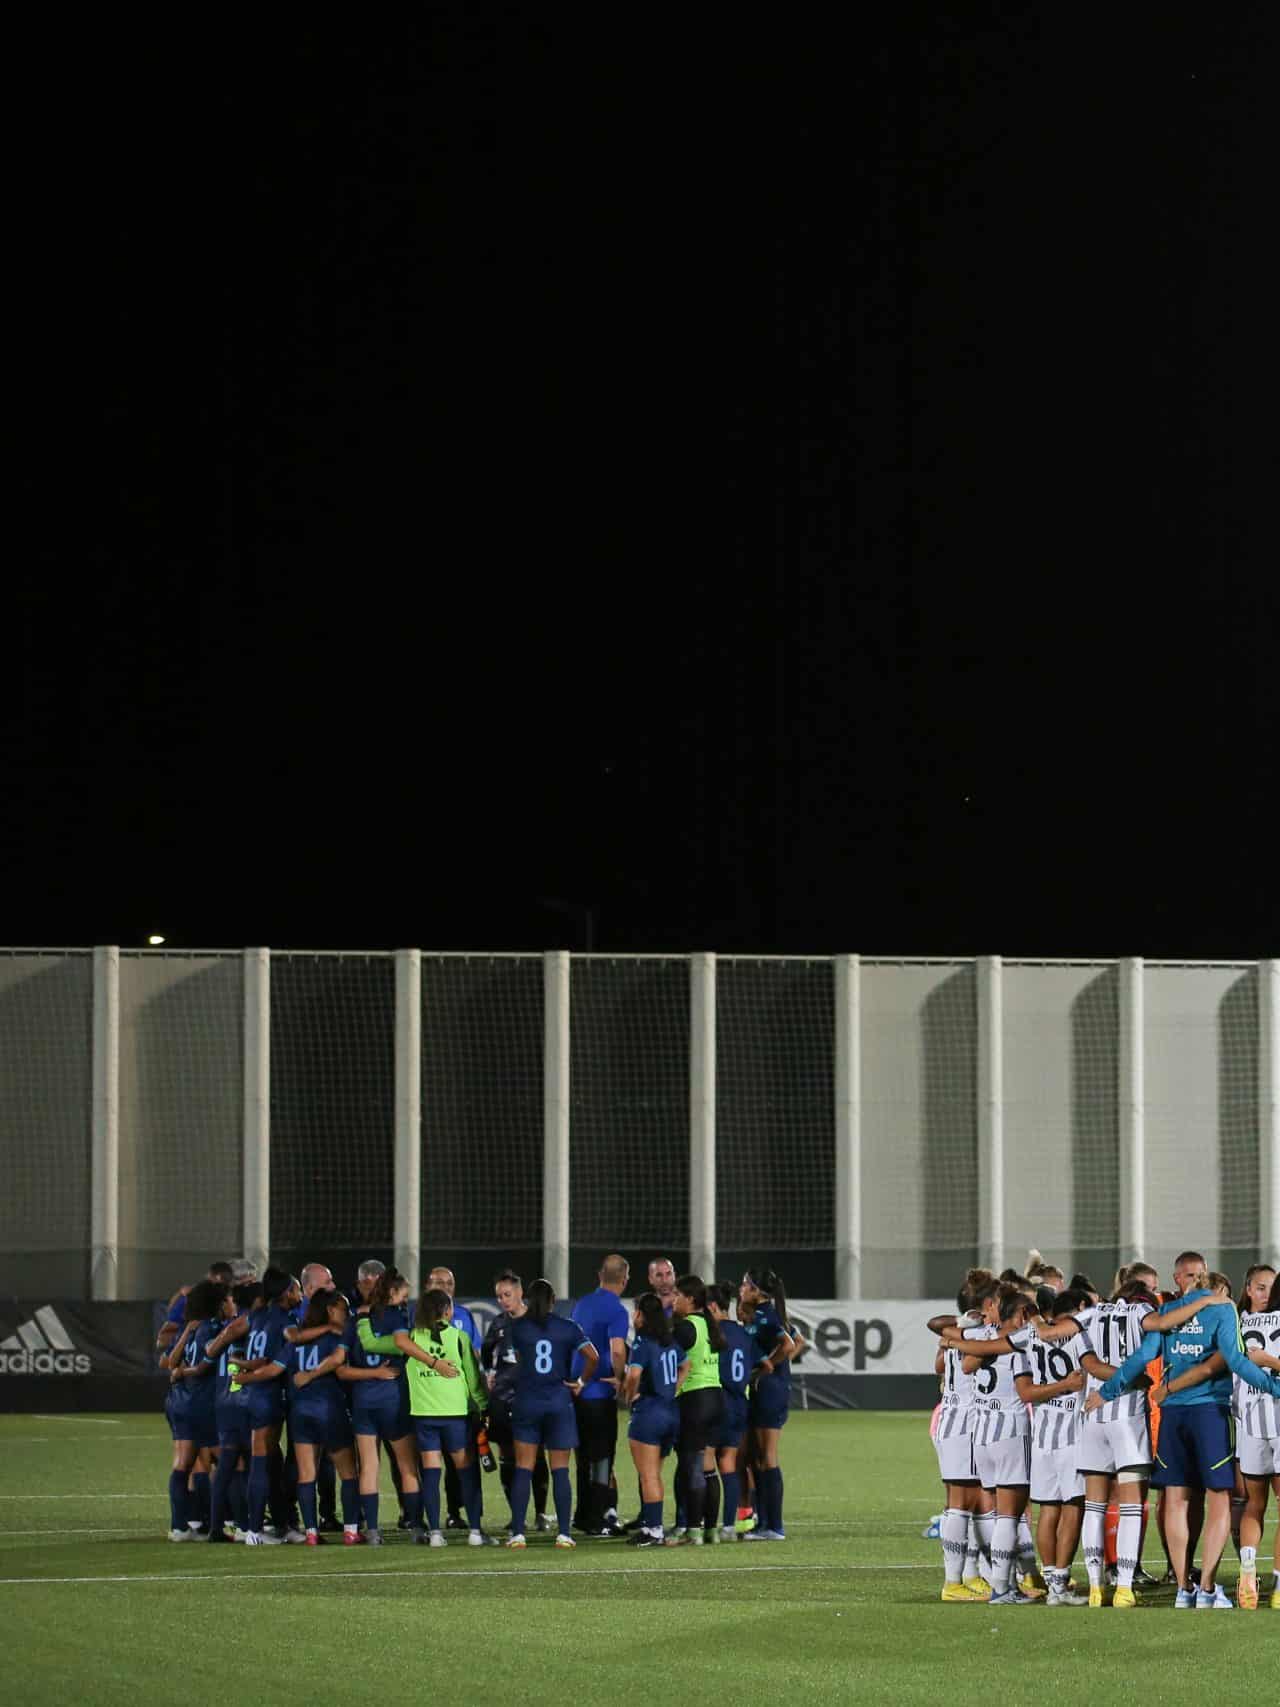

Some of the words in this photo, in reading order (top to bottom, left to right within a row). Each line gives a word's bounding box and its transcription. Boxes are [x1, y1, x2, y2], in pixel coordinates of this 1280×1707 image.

[1098, 1314, 1127, 1364] 11
[1171, 1341, 1203, 1357] Jeep
[296, 1345, 319, 1372] 14
[535, 1339, 552, 1374] 8
[660, 1349, 677, 1385] 10
[732, 1348, 744, 1382] 6
